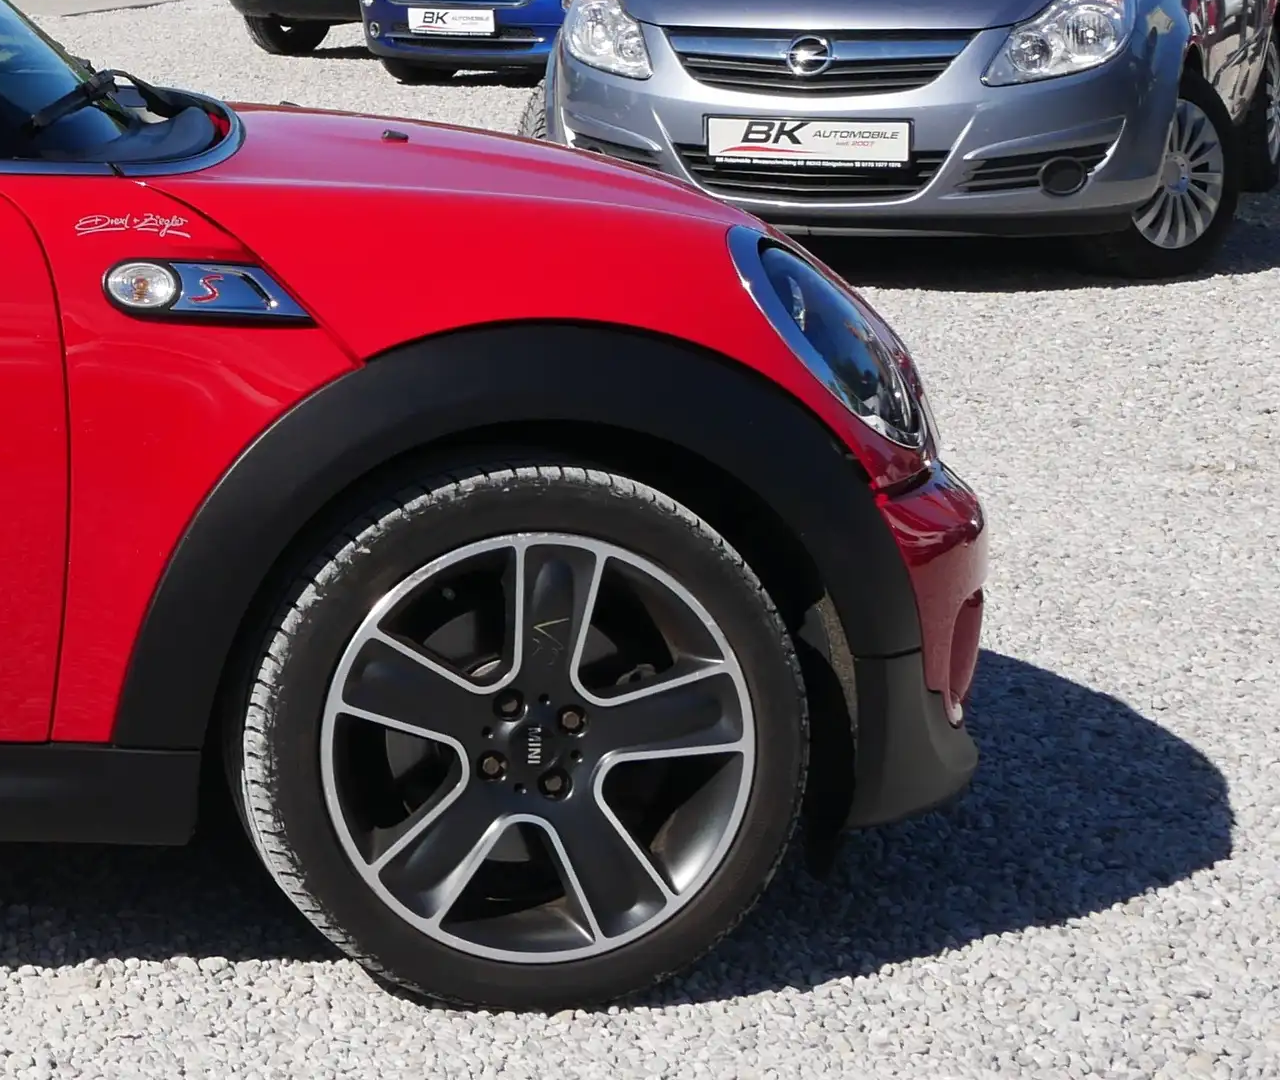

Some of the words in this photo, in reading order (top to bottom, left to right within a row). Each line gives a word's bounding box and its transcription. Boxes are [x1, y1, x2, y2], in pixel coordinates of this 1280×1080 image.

[423, 11, 450, 24] BK
[741, 121, 811, 145] BK
[812, 130, 900, 140] AUTOMOBILE
[189, 273, 224, 303] S
[527, 727, 542, 764] MINI
